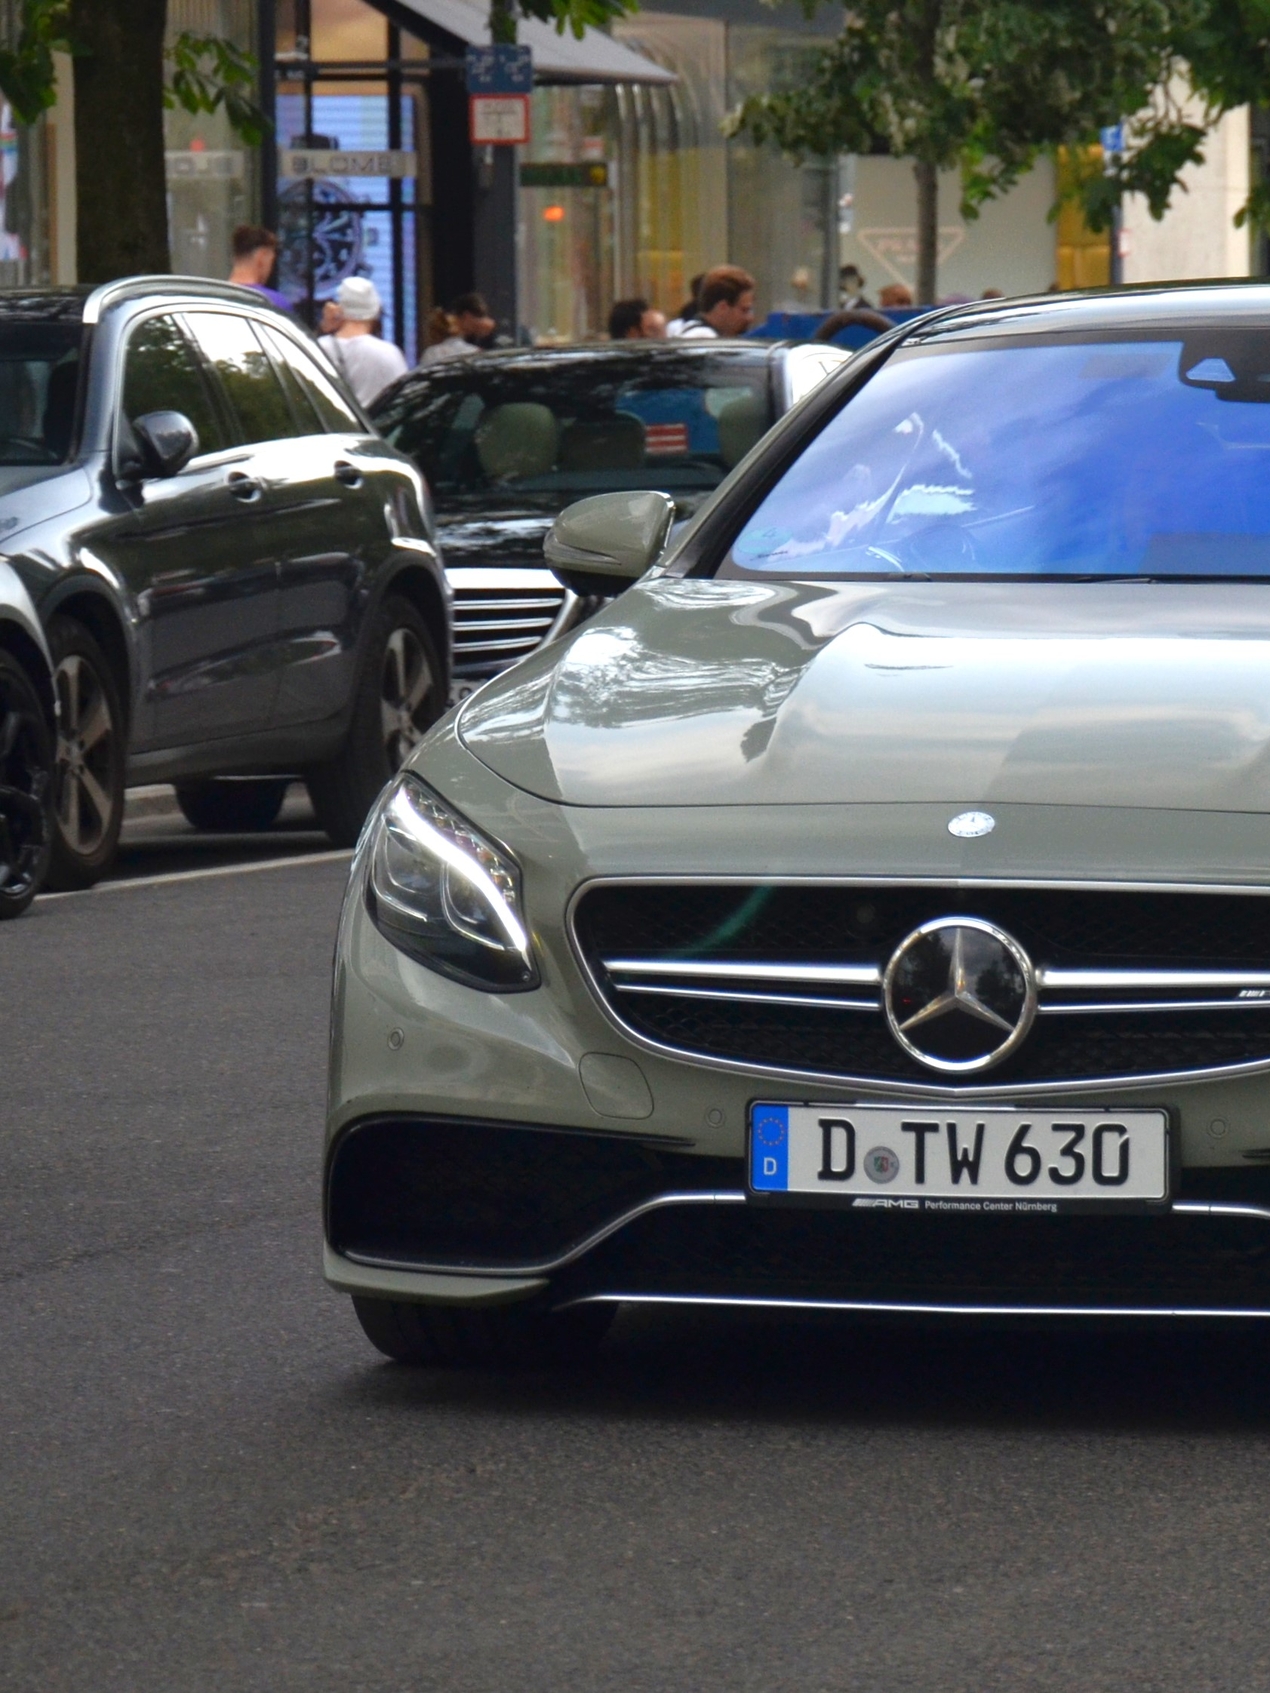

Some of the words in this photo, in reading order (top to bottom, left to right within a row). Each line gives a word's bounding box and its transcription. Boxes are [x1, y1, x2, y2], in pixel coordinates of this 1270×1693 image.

[763, 1157, 777, 1176] D
[817, 1118, 856, 1181] D
[901, 1121, 985, 1185] TW
[1004, 1123, 1130, 1186] 630
[871, 1199, 919, 1209] AMG
[925, 1201, 980, 1211] Performance
[983, 1202, 1013, 1211] Center
[1015, 1202, 1057, 1213] Nürnberg
